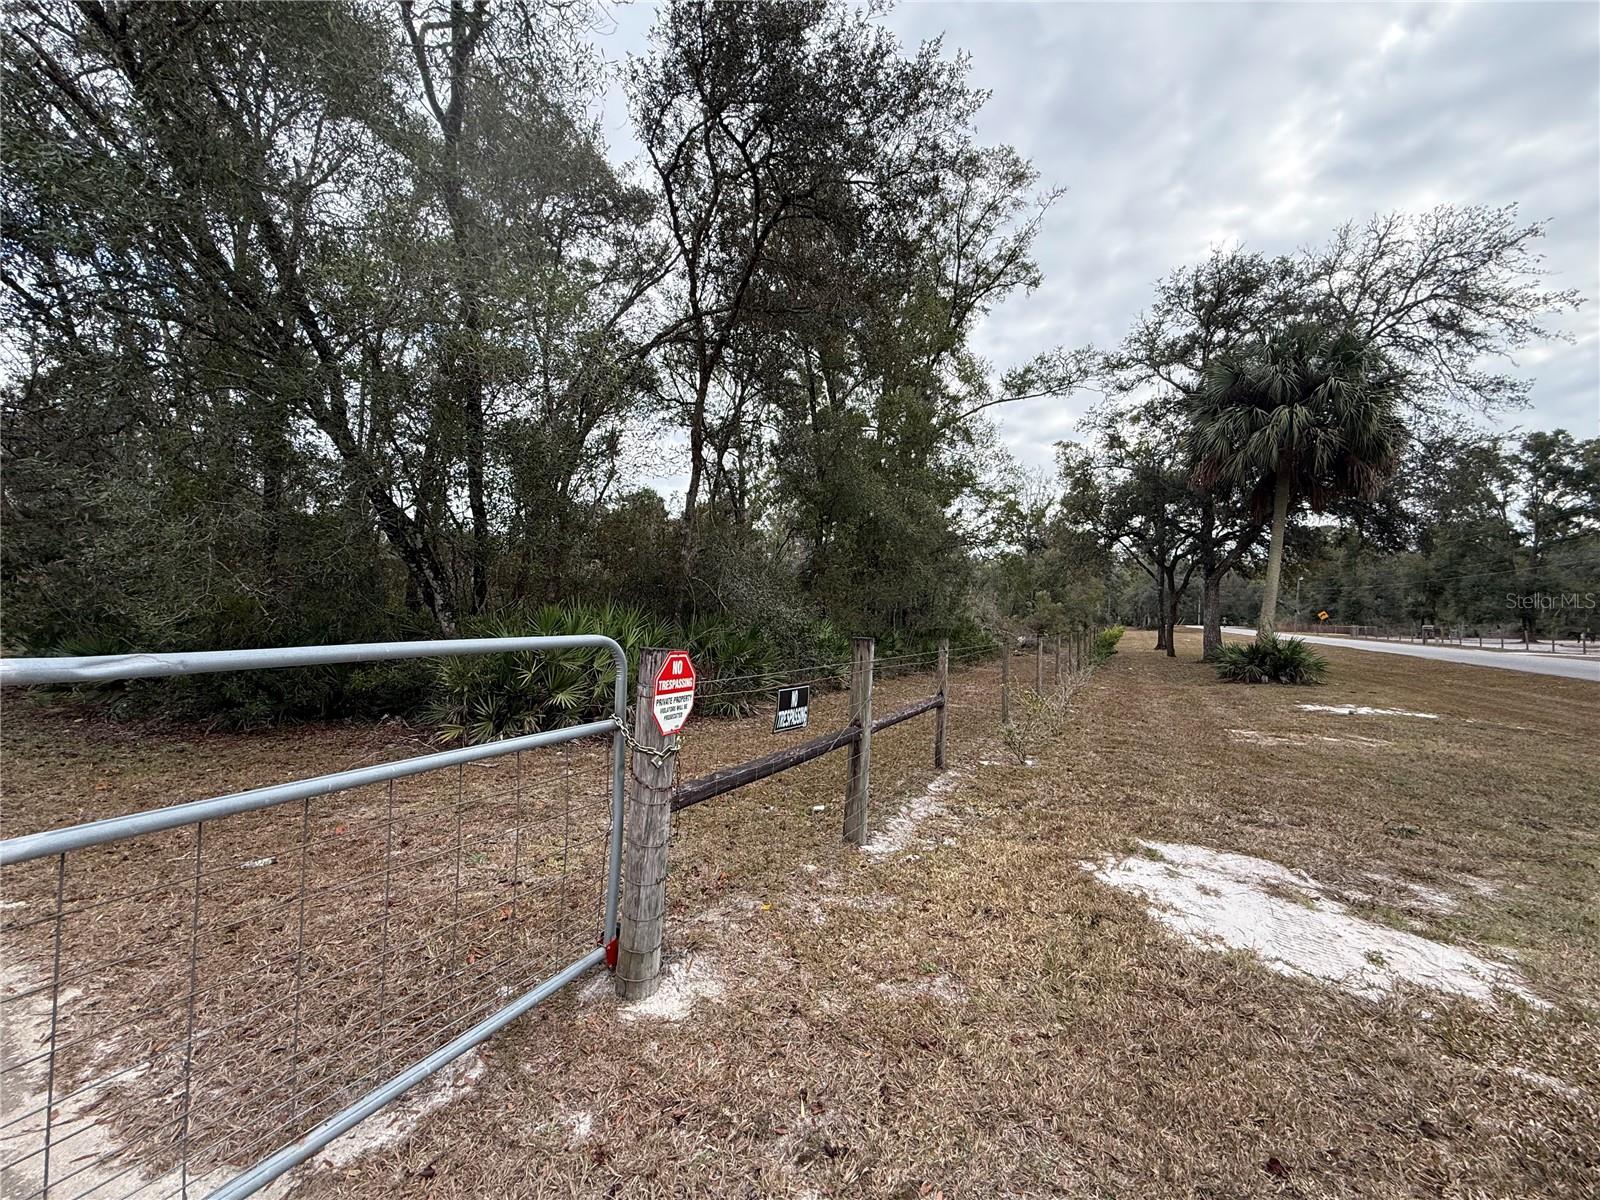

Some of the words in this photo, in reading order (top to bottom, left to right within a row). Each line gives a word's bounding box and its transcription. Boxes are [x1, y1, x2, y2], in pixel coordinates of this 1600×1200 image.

[672, 660, 683, 675] NO
[659, 678, 693, 691] TRESPASSING
[656, 697, 673, 706] PRIVATE
[674, 694, 692, 703] PROPERTY
[791, 690, 798, 708] NO
[776, 706, 808, 728] TRESPASSING
